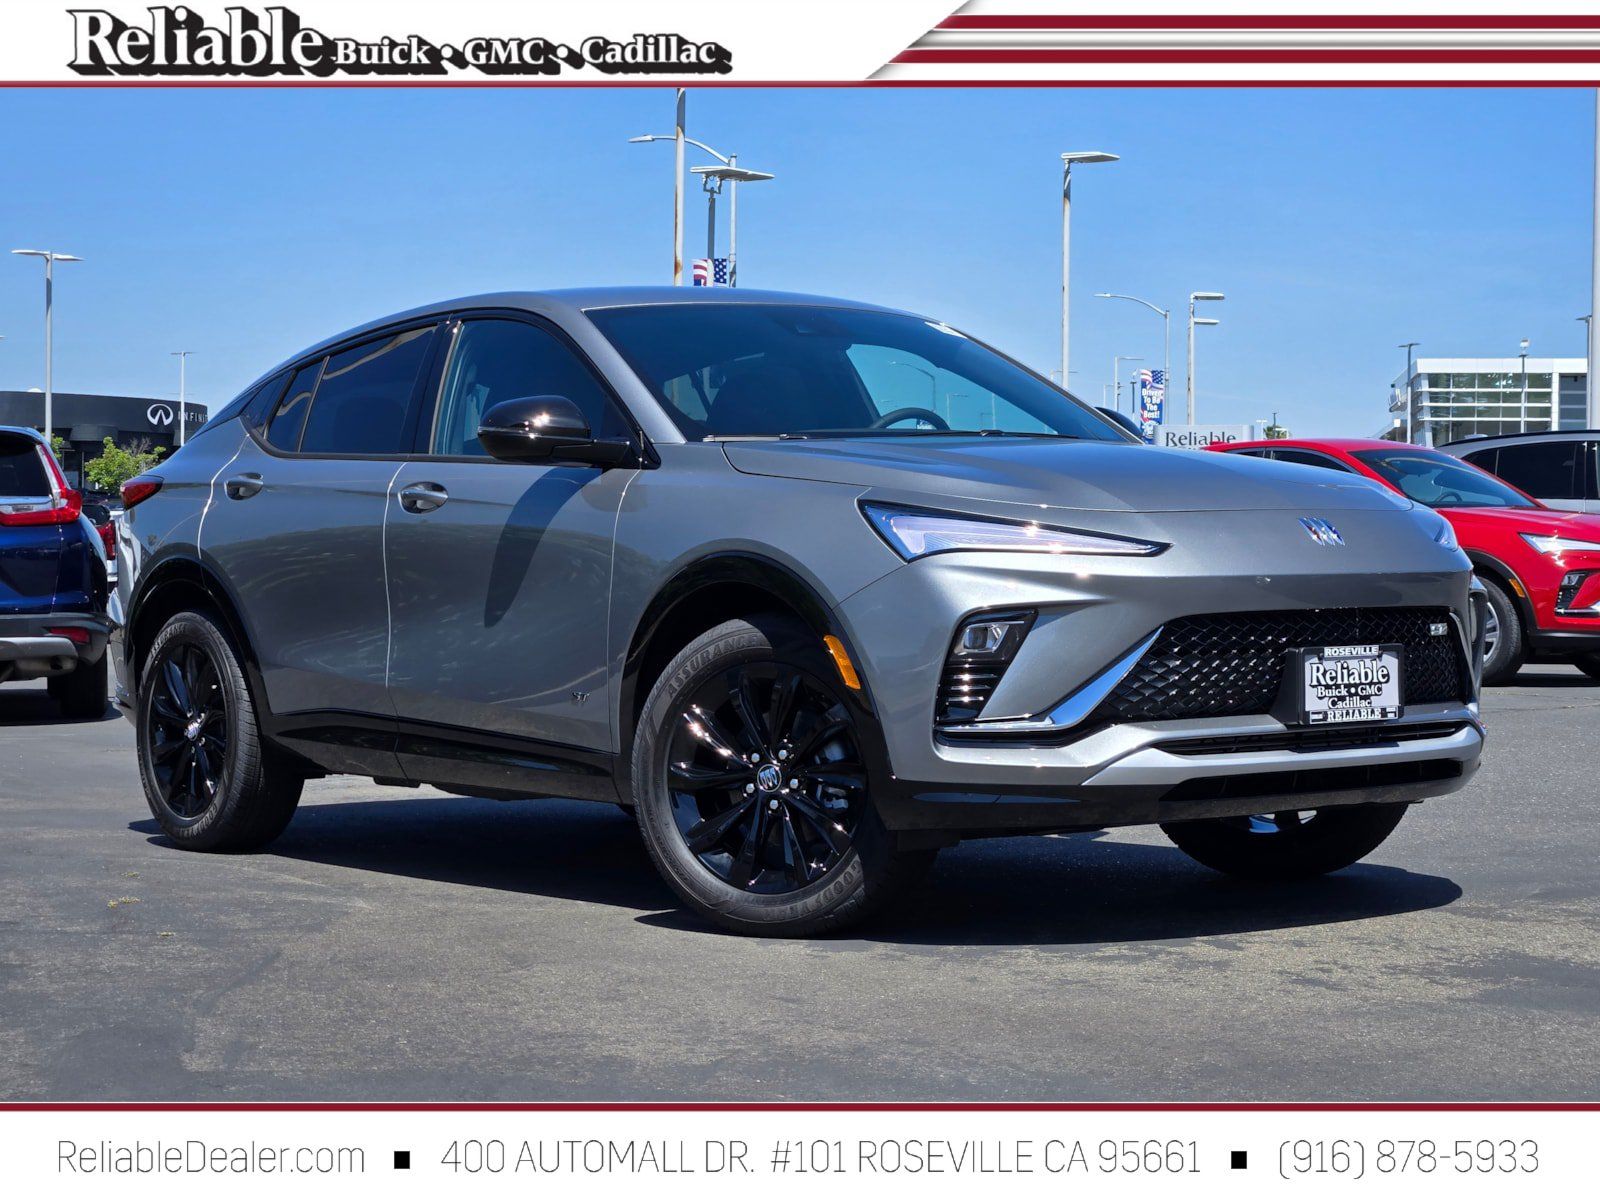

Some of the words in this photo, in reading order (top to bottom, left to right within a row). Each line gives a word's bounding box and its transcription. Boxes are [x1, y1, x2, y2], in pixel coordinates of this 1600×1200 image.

[1165, 431, 1237, 447] Reliable
[1325, 646, 1379, 657] ROSEVILLE
[1309, 660, 1390, 686] Reliable
[1316, 685, 1348, 698] Buick
[1357, 684, 1383, 696] GMC
[1327, 696, 1373, 709] Cadillac
[1327, 708, 1382, 721] RELIABLE
